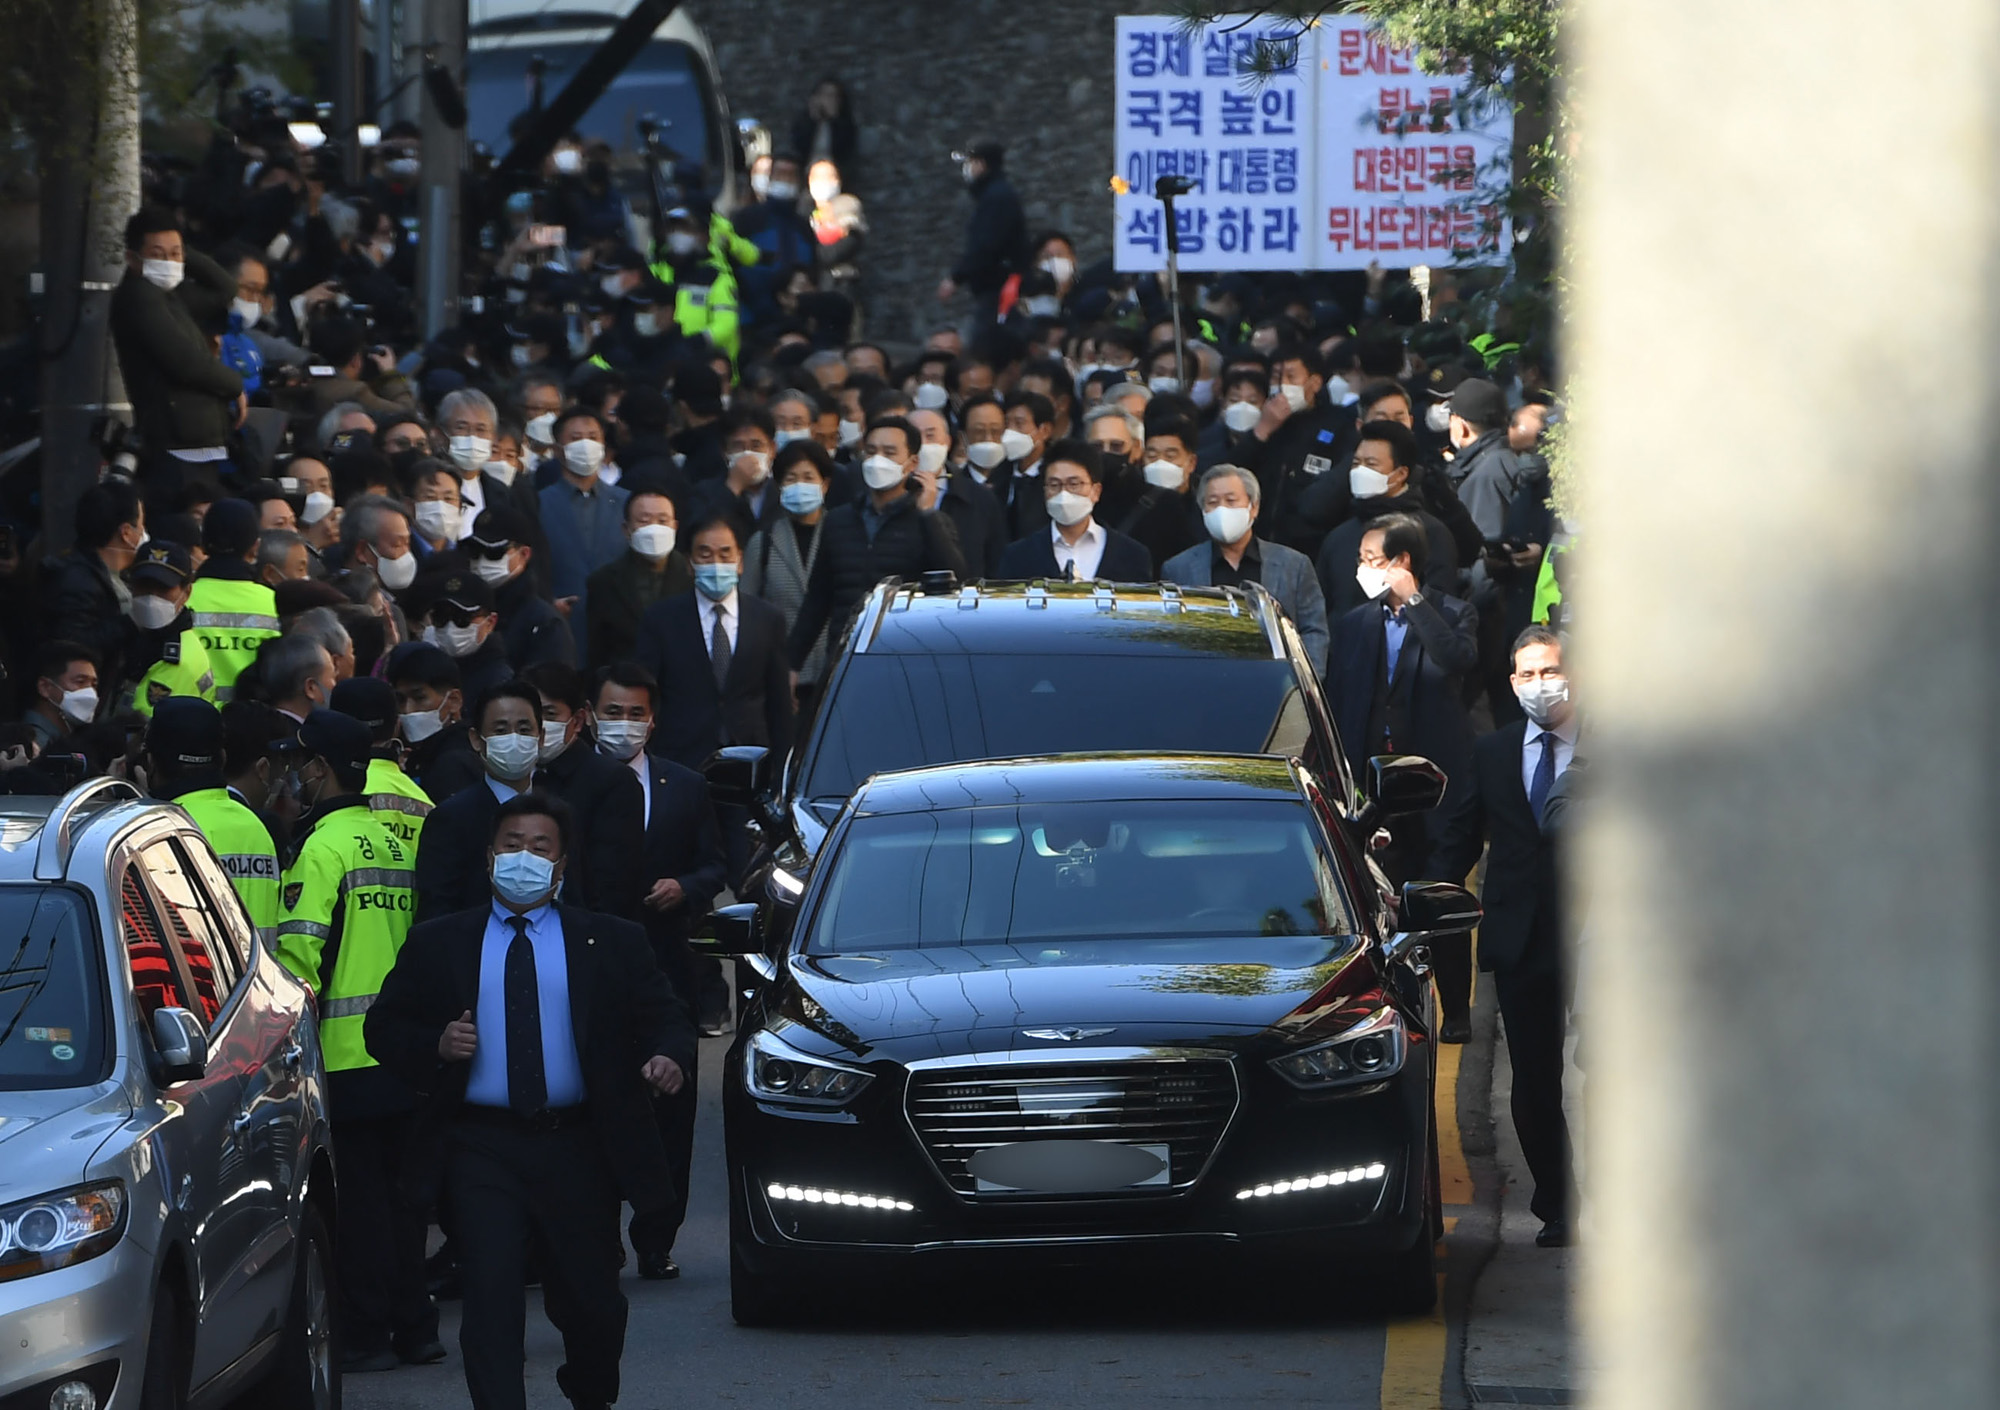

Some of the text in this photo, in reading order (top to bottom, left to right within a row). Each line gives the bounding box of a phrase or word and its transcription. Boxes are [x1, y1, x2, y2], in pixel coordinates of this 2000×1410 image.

[1129, 31, 1190, 77] 경제
[1128, 89, 1295, 136] 국격 높인
[1128, 147, 1298, 195] 이명박 대통령
[1353, 145, 1476, 192] 대한민국을
[199, 635, 258, 651] OLIC
[356, 891, 413, 912] POLIC
